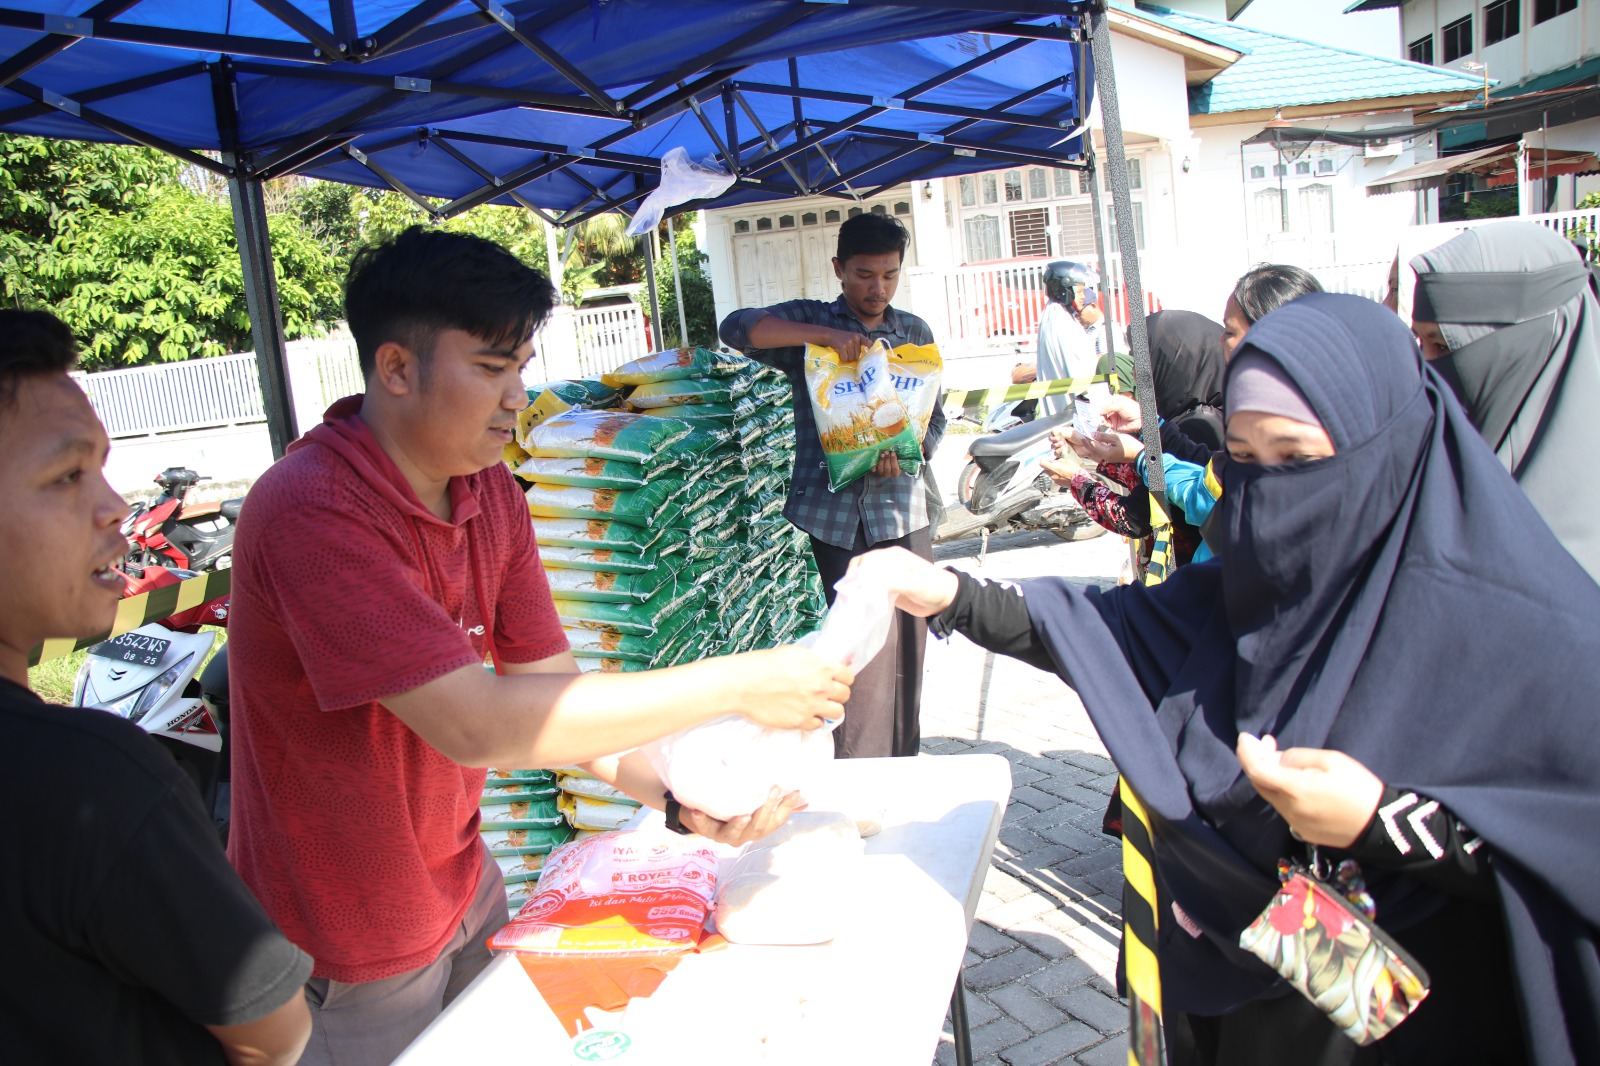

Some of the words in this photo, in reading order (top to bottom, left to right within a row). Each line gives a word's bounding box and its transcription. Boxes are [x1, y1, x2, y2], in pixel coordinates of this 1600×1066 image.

[109, 633, 167, 653] 3542WS
[143, 656, 158, 665] 25
[167, 705, 198, 728] HONDA
[628, 871, 673, 883] ROYAL
[604, 898, 626, 906] dan
